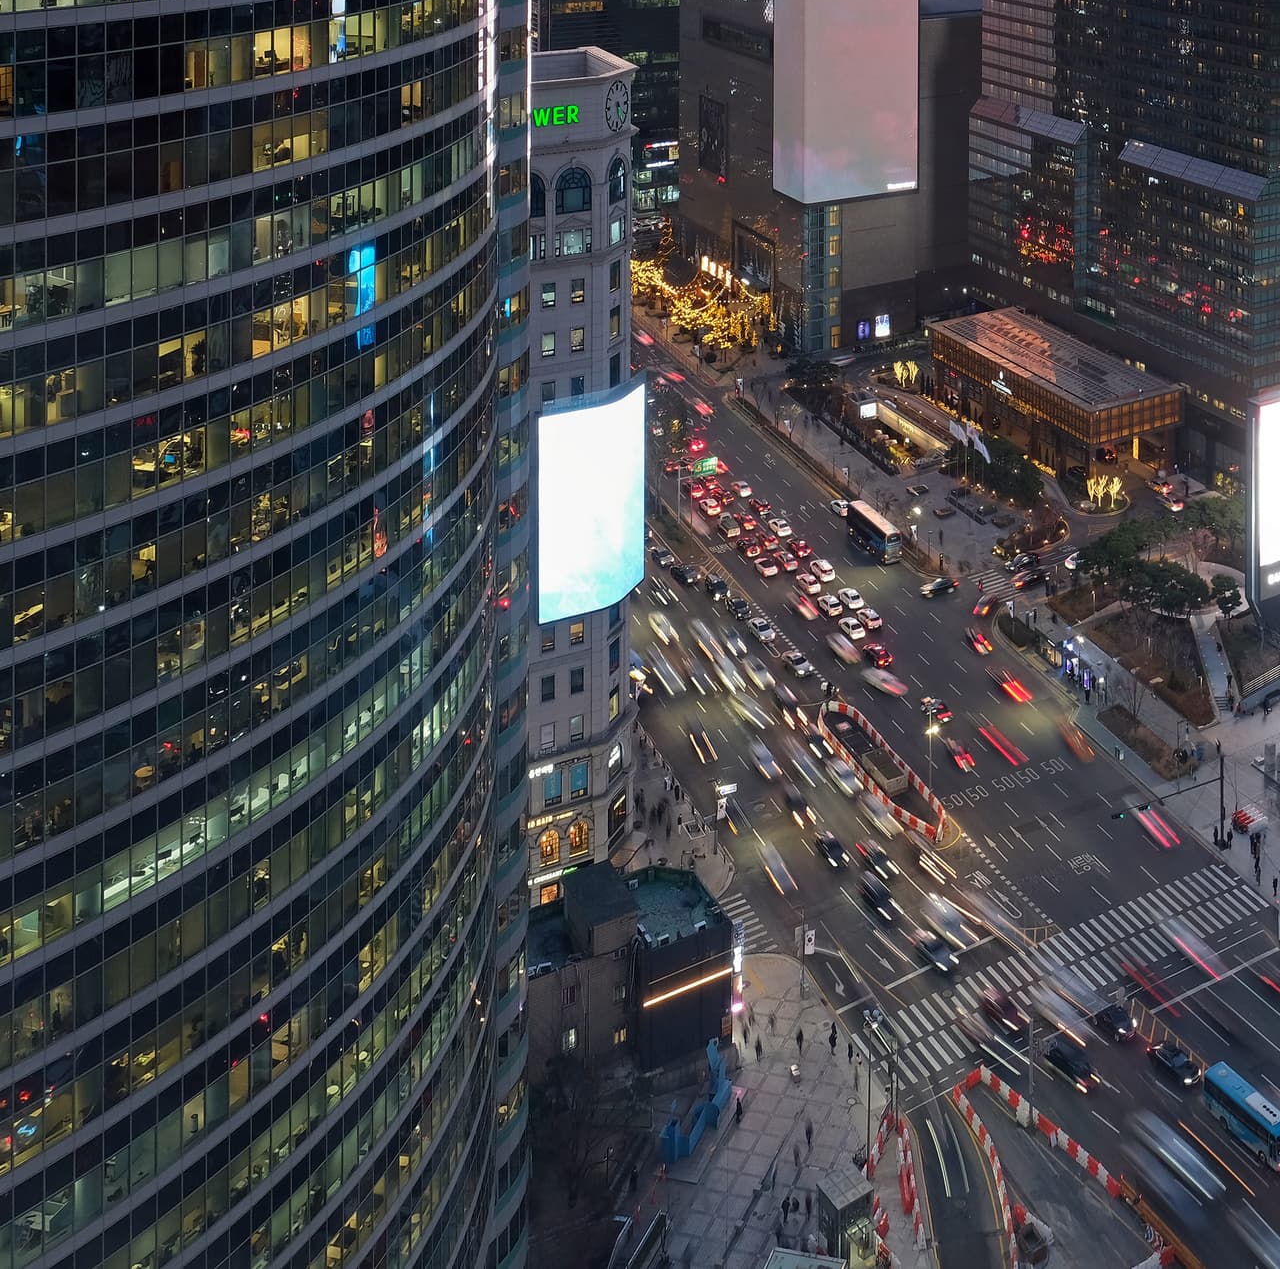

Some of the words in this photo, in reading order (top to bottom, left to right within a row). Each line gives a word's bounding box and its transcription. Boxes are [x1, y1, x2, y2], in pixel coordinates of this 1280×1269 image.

[966, 785, 989, 801] 50
[992, 775, 1015, 792] 50
[1016, 767, 1041, 784] 50
[1040, 758, 1065, 775] 50
[1067, 852, 1100, 875] 선릉역
